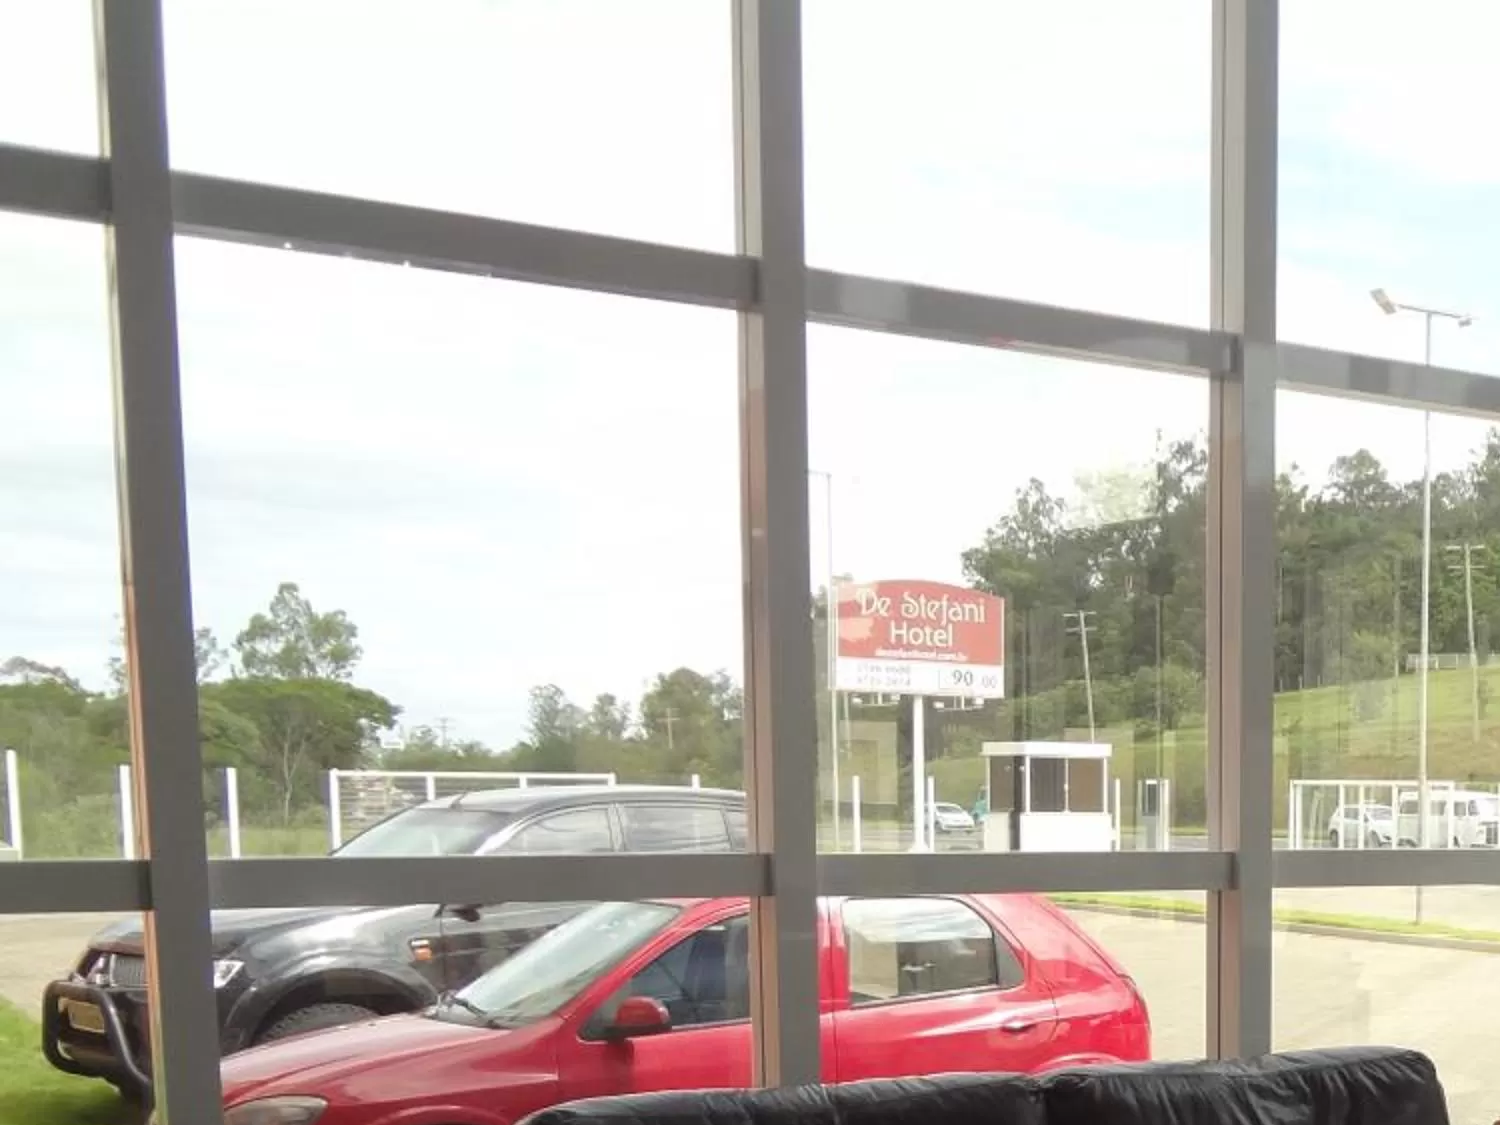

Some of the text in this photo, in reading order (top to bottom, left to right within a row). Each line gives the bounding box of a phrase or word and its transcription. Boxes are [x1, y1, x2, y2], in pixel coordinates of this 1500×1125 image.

[856, 588, 986, 626] De Stefani
[889, 620, 954, 648] Hotel
